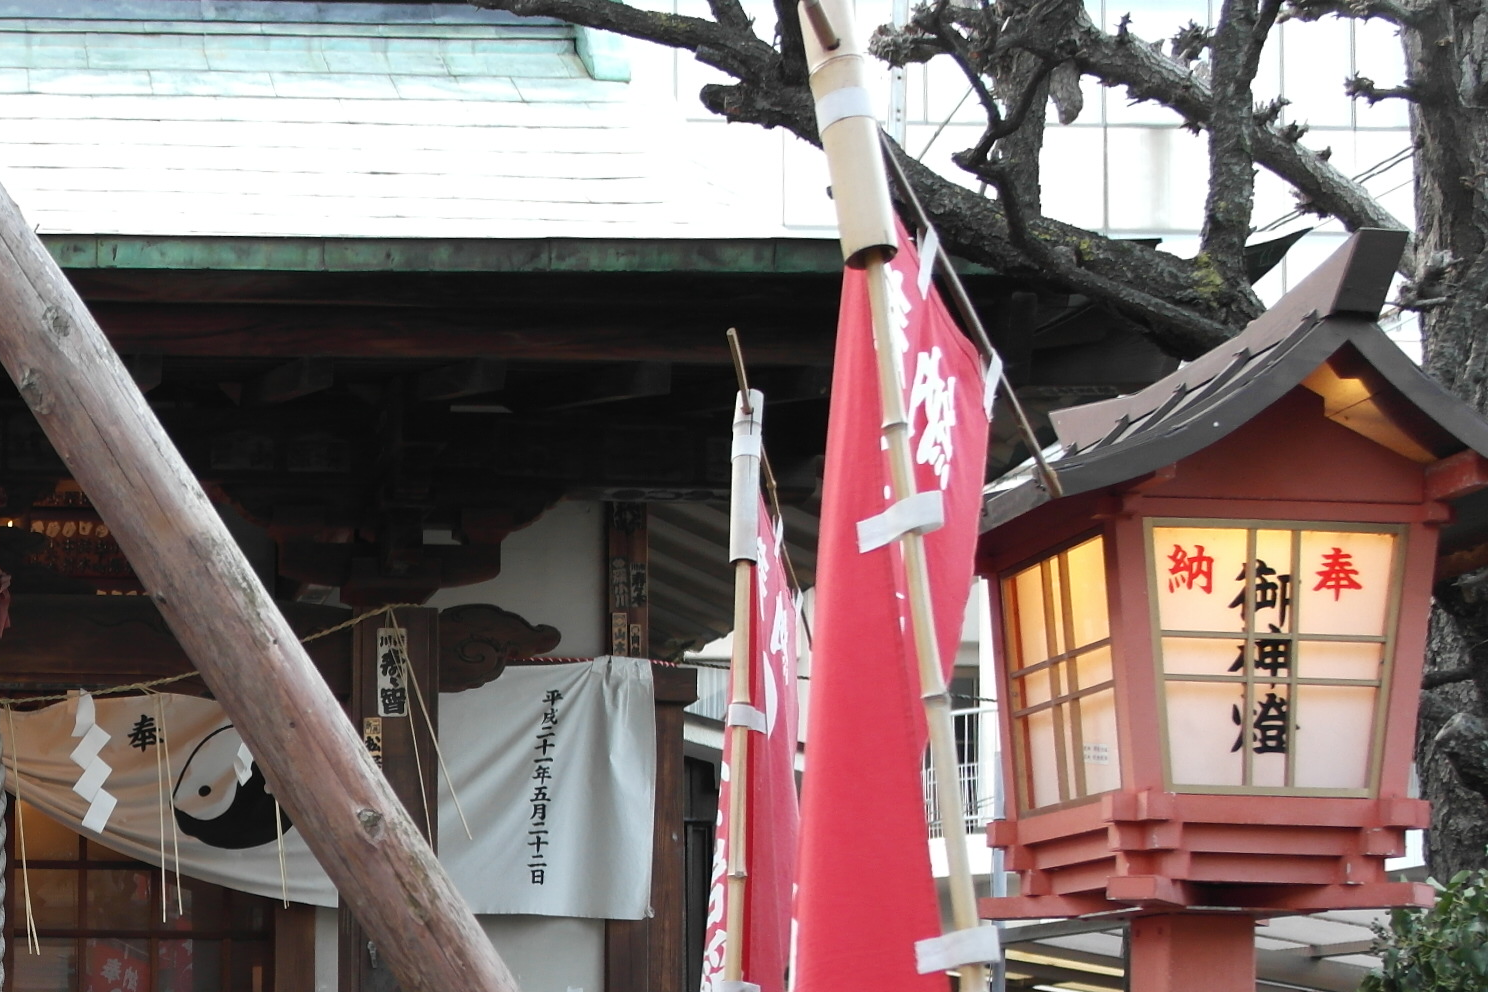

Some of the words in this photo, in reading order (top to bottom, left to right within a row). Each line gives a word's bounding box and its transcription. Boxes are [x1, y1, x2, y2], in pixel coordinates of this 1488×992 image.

[1167, 544, 1214, 595] 納
[1313, 547, 1362, 602] 奉
[1227, 559, 1300, 755] 御神燈
[127, 714, 164, 751] 奉
[527, 689, 565, 886] 平成二十一年五月二十二日
